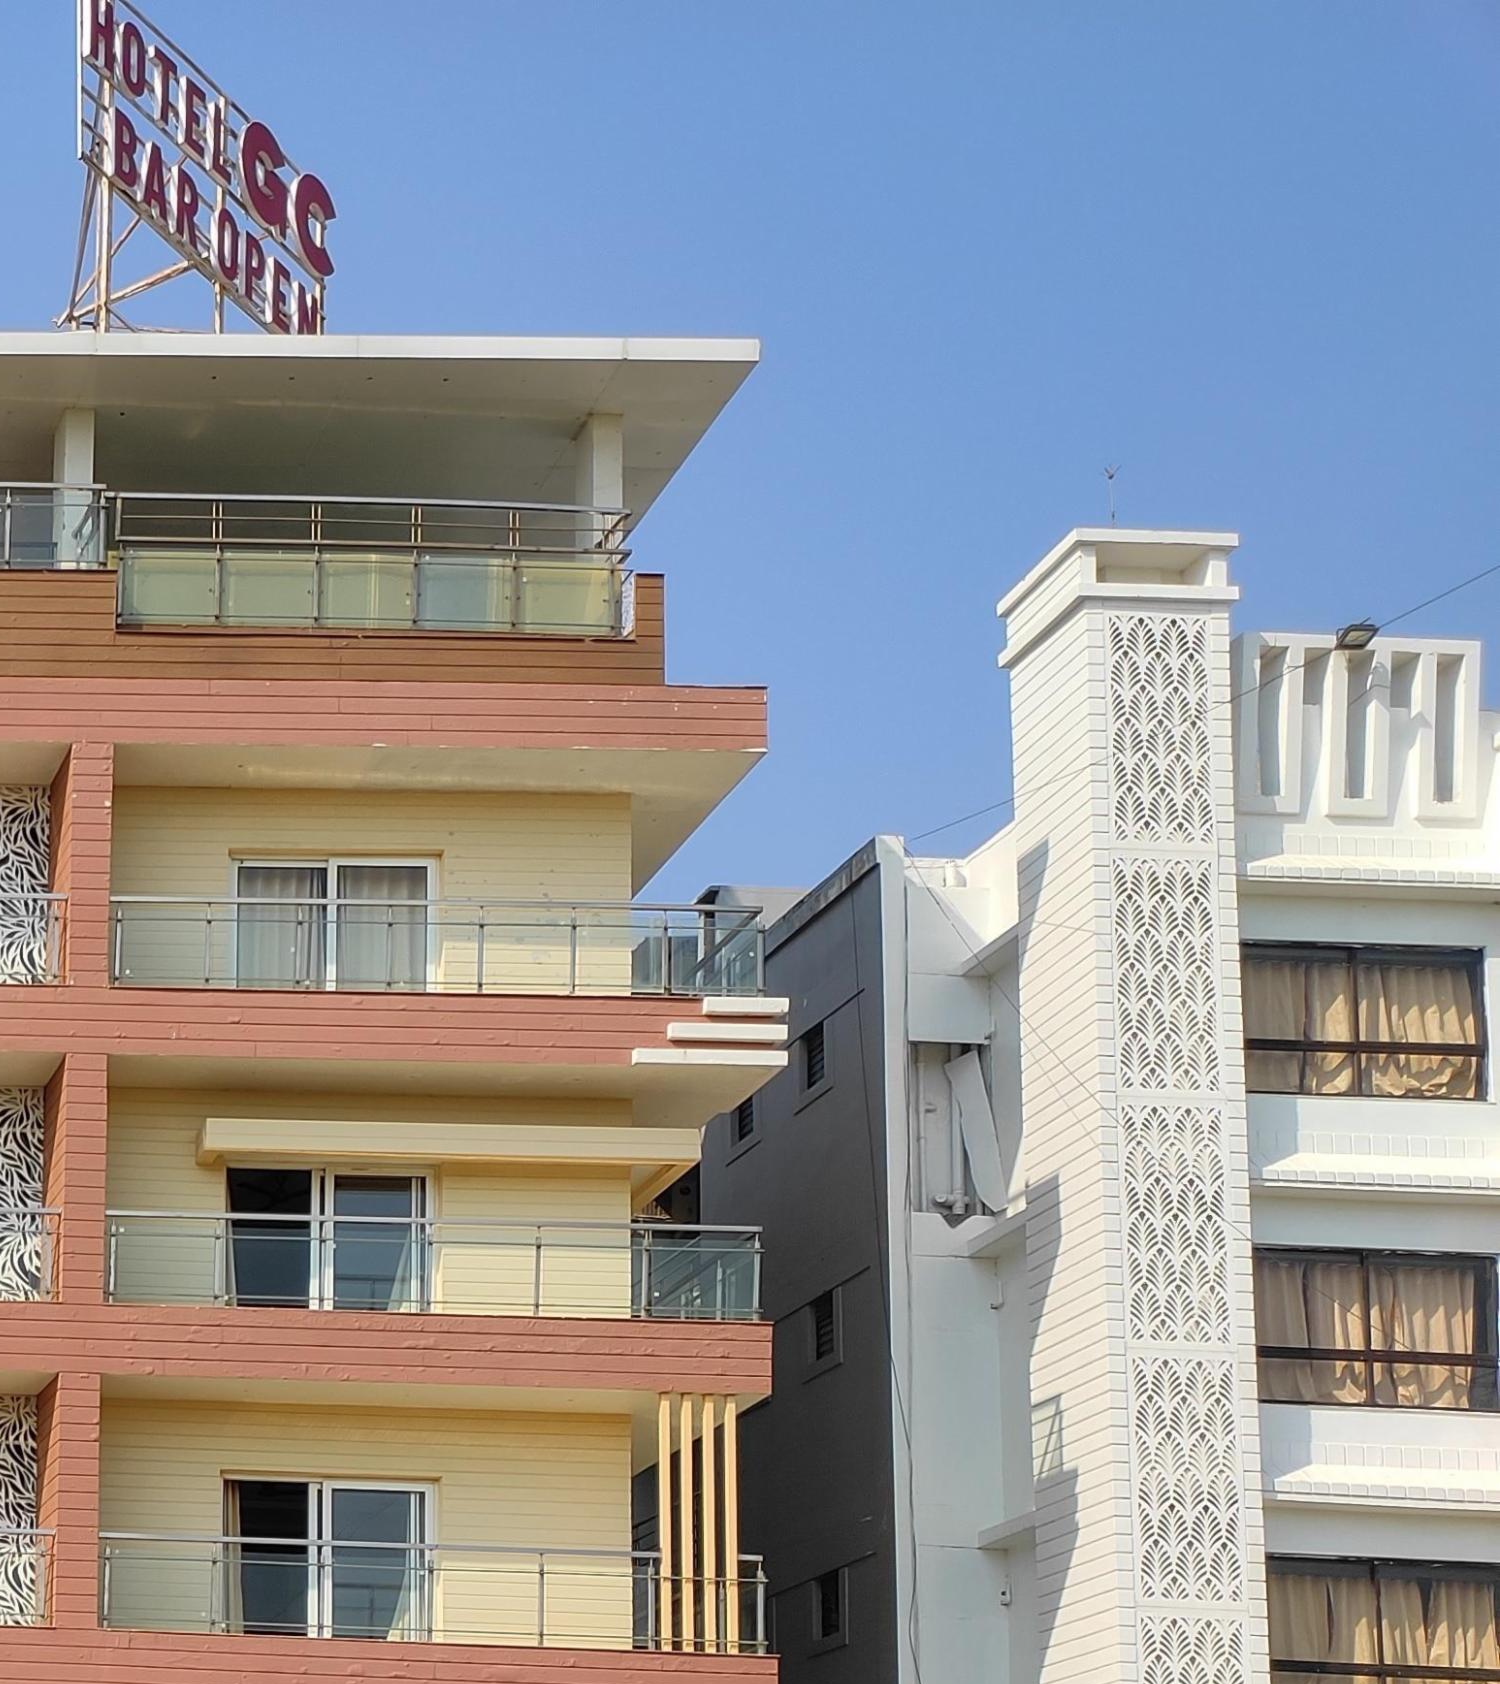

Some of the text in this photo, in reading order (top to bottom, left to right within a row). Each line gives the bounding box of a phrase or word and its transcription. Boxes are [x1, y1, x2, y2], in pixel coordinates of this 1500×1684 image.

[83, 0, 337, 278] HOTEL GC
[111, 107, 319, 335] BAR OPEN
